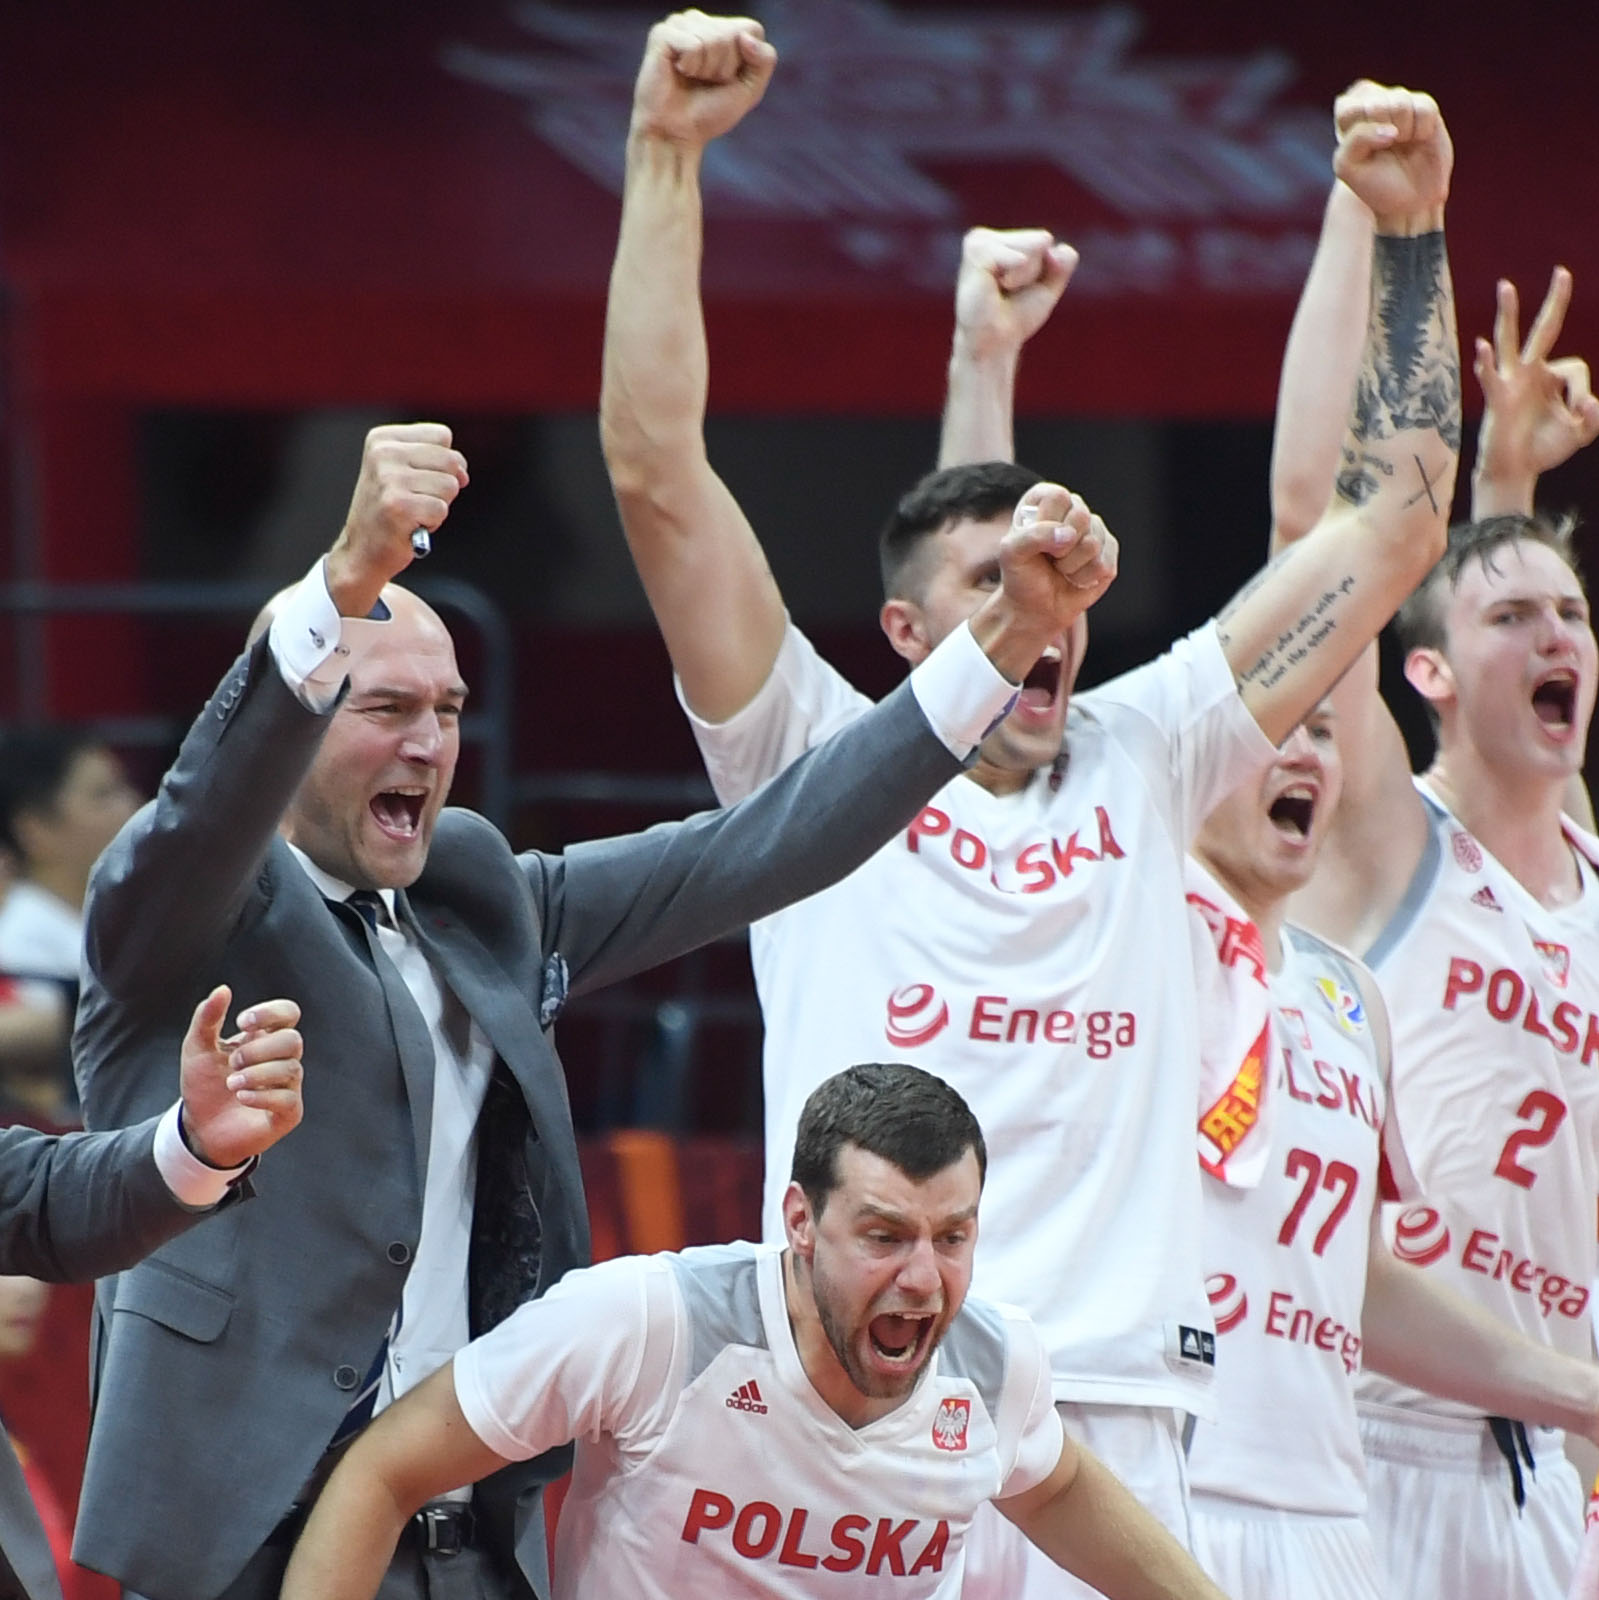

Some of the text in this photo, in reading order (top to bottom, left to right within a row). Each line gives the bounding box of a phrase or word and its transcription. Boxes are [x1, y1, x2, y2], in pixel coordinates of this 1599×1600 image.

[907, 805, 1127, 894] POSKA
[969, 995, 1136, 1060] Enega
[1494, 1089, 1568, 1190] 2
[1277, 1147, 1359, 1257] 77
[1460, 1227, 1590, 1320] Energa
[725, 1397, 769, 1415] adidas
[681, 1488, 950, 1577] POLSKA
